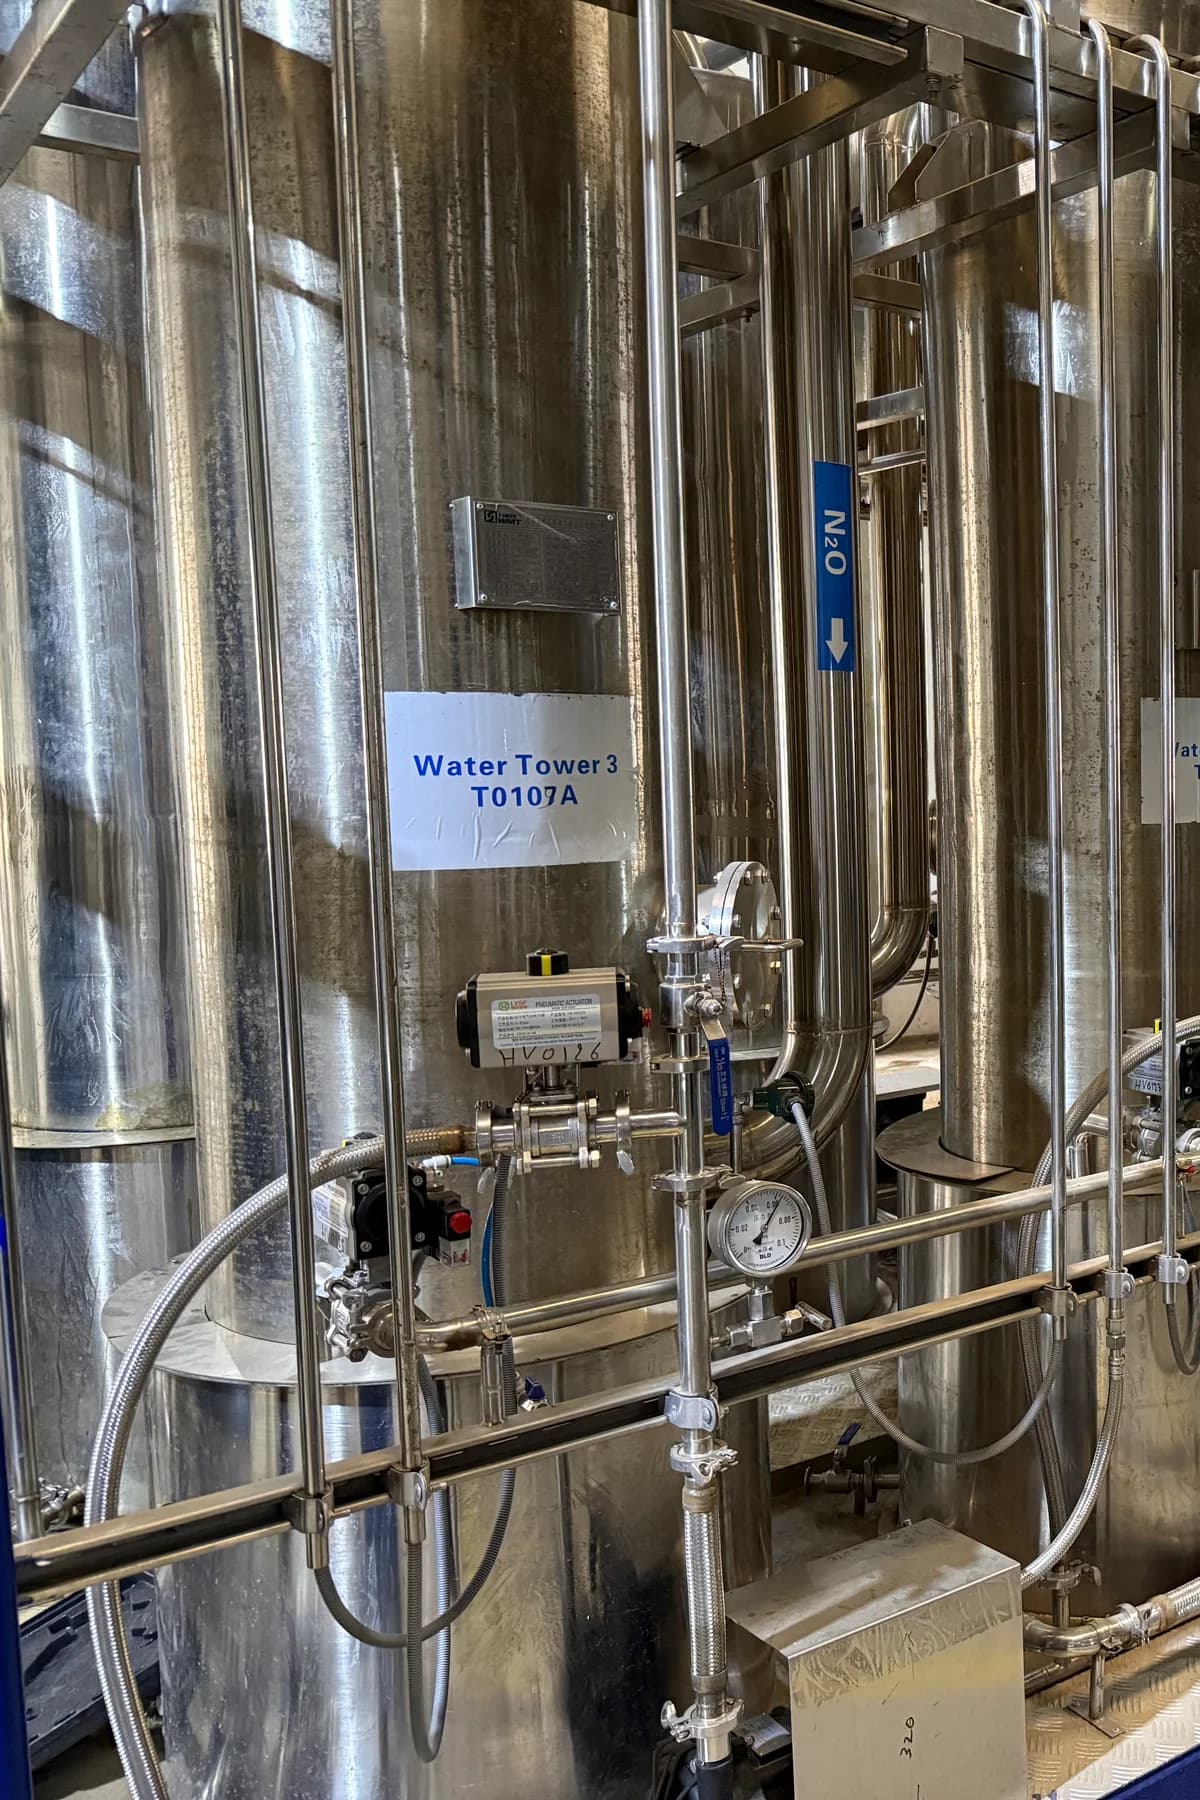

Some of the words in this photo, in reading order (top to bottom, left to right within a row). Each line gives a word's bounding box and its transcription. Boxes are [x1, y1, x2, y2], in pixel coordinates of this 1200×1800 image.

[413, 754, 507, 777] Water
[515, 754, 600, 776] Tower
[606, 754, 618, 774] 3
[498, 1041, 601, 1067] HV0126
[899, 1716, 915, 1759] 320
